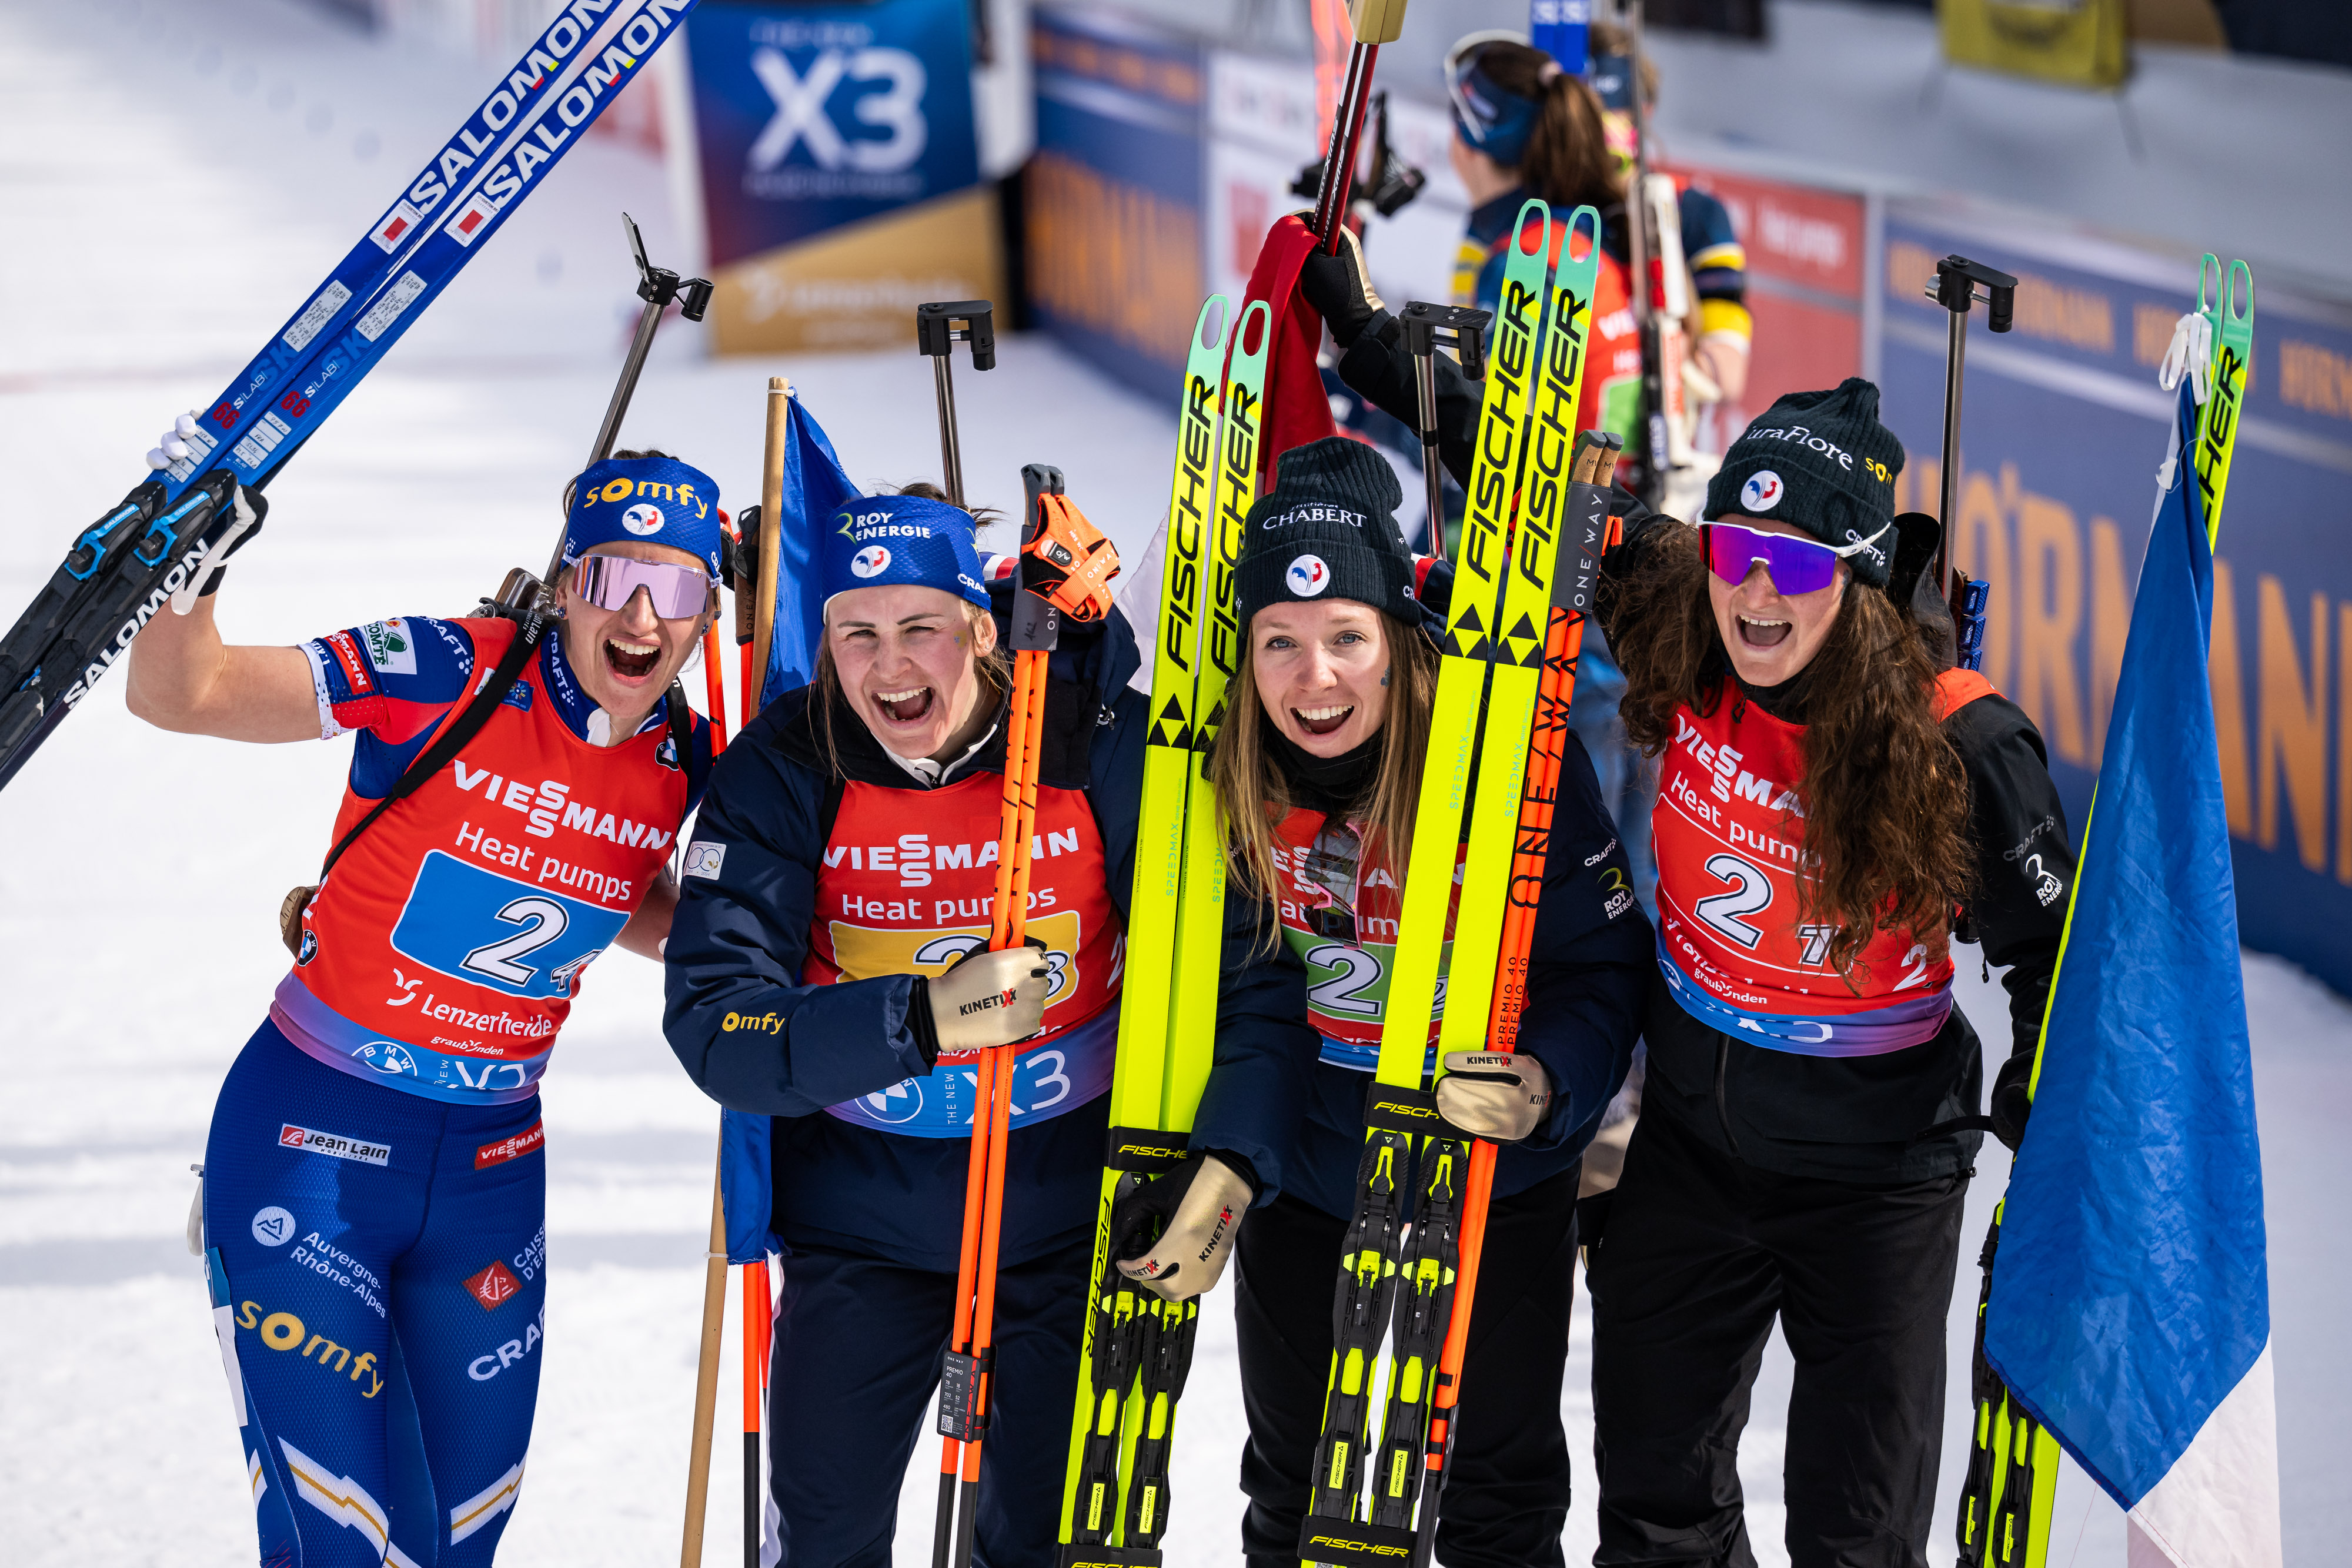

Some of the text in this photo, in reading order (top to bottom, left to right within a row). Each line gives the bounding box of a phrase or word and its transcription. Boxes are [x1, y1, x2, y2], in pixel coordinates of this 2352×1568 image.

[748, 47, 929, 175] X3
[1325, 117, 1338, 174] SWIX
[1332, 147, 1345, 200] SWIX
[212, 402, 240, 430] 66
[280, 390, 311, 418] 66
[1467, 280, 1536, 583] FISCHER
[1521, 289, 1586, 591] FISCHER
[103, 505, 135, 531] SALOMON
[584, 478, 707, 519] somfy
[856, 513, 893, 527] ROY
[1167, 375, 1214, 673] FISCHER
[1263, 509, 1367, 530] CHABERT
[856, 525, 930, 541] ENERGIE
[1211, 382, 1258, 675] FISCHER
[63, 539, 209, 710] SALOMON
[525, 623, 541, 644] Lain
[551, 631, 568, 688] CRAFT
[1449, 734, 1469, 810] SPEEDMAX
[1505, 743, 1524, 817] SPEEDMAX
[455, 760, 671, 850] VIESSMANN
[1671, 771, 1722, 829] Heat
[455, 821, 631, 902] Heat pumps
[1165, 823, 1179, 896] SPEEDMAX
[1584, 842, 1612, 867] CRAFT
[842, 894, 921, 920] Heat
[1603, 890, 1626, 912] ROY
[1695, 853, 1774, 951] 2
[2036, 877, 2056, 900] ROY
[459, 895, 569, 985] 2
[1305, 943, 1384, 1017] 2
[1893, 944, 1927, 992] 2
[421, 994, 552, 1037] Lenzerheide
[722, 1011, 785, 1035] omfy
[1498, 957, 1517, 1044] PREMIO 40
[1507, 958, 1529, 1045] PREMIO 40
[363, 1045, 412, 1069] BMW
[944, 1073, 957, 1125] THE NEW
[304, 1134, 388, 1159] Jean Lain
[320, 1148, 368, 1161] MOBILITÉS
[481, 1128, 544, 1159] VIESSMANN
[1118, 1145, 1187, 1159] FISCHE
[290, 1246, 386, 1318] Rhône-Alpes
[302, 1231, 382, 1290] Auvergne-
[1085, 1195, 1110, 1358] FISCHER
[235, 1300, 384, 1399] somfy
[947, 1366, 963, 1375] PREMIO
[1335, 1451, 1343, 1485] FISCHER
[1395, 1460, 1403, 1493] FISCHER
[1309, 1536, 1409, 1557] FISCHER
